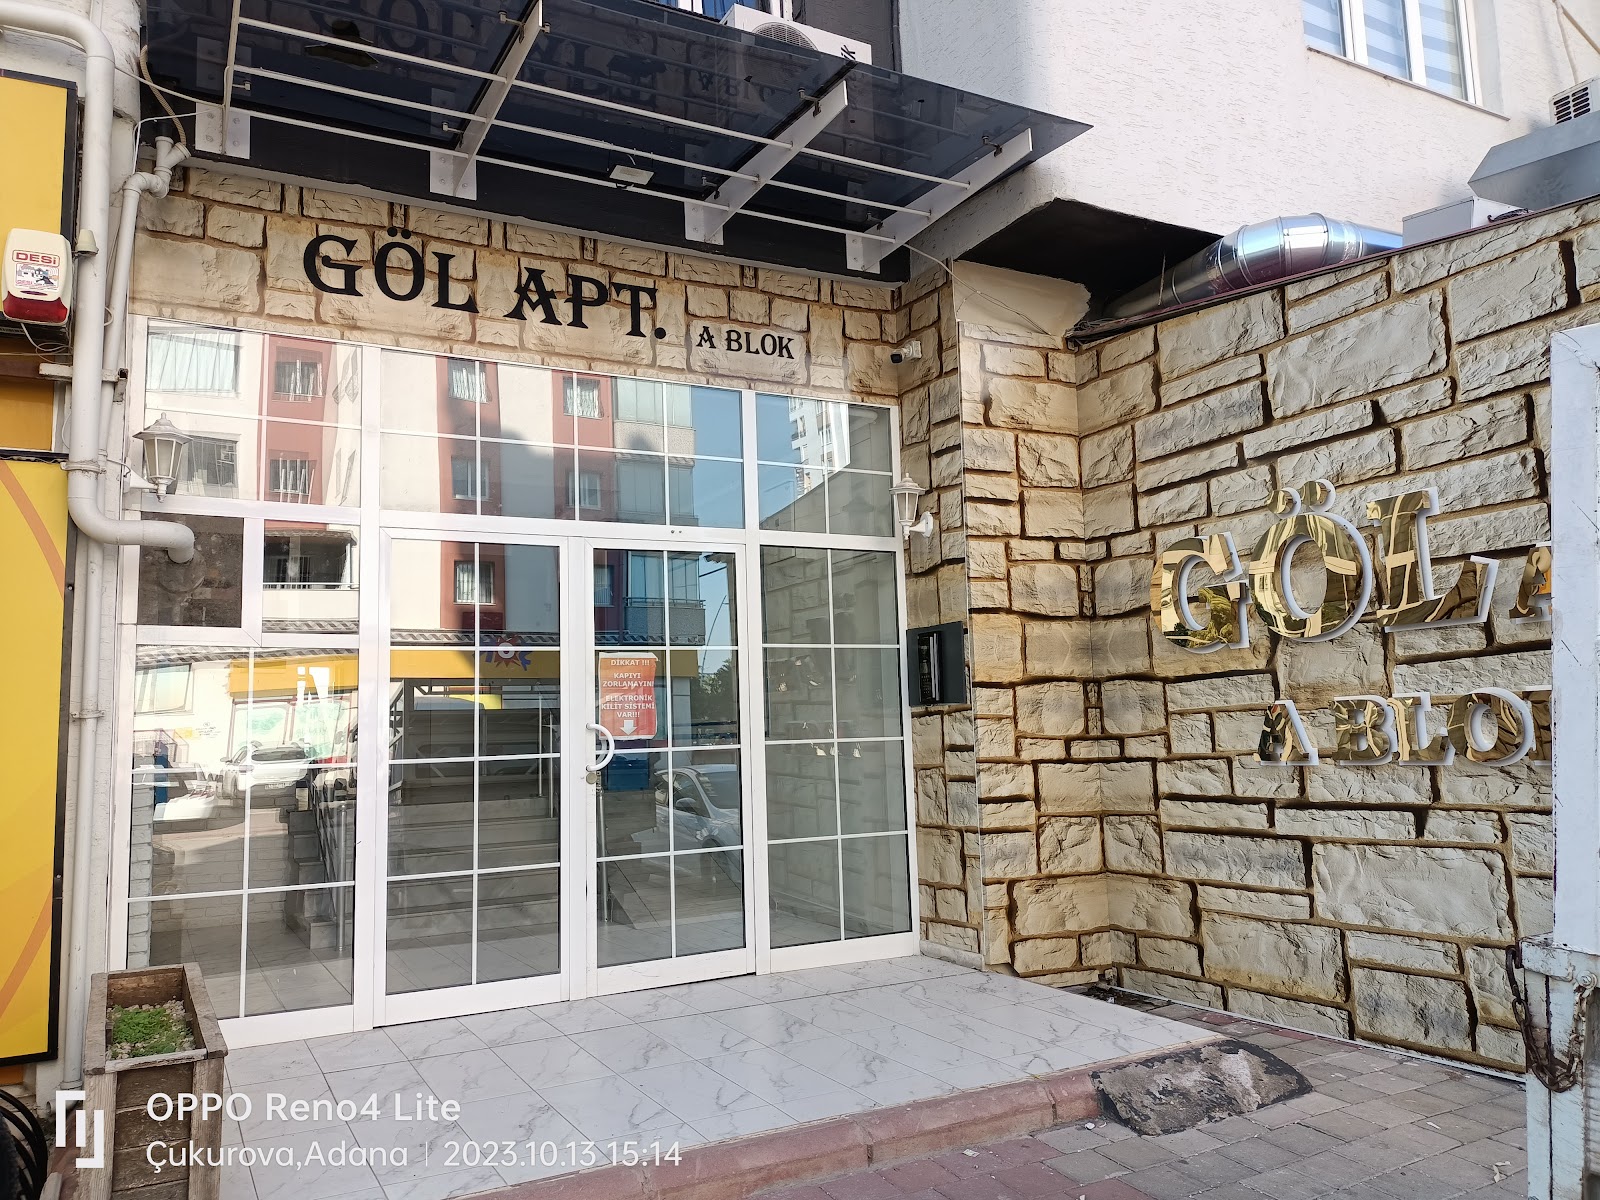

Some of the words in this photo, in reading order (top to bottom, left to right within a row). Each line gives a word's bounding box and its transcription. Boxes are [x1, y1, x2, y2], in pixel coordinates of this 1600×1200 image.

[16, 252, 57, 265] DESi
[303, 226, 480, 313] GÖL
[503, 266, 668, 340] APT.
[696, 325, 717, 349] A
[725, 329, 795, 360] BLOK
[1150, 478, 1500, 654] GÖL
[610, 658, 640, 666] DİKKAT
[624, 702, 655, 710] SİSTEMİ
[1253, 699, 1319, 767] A
